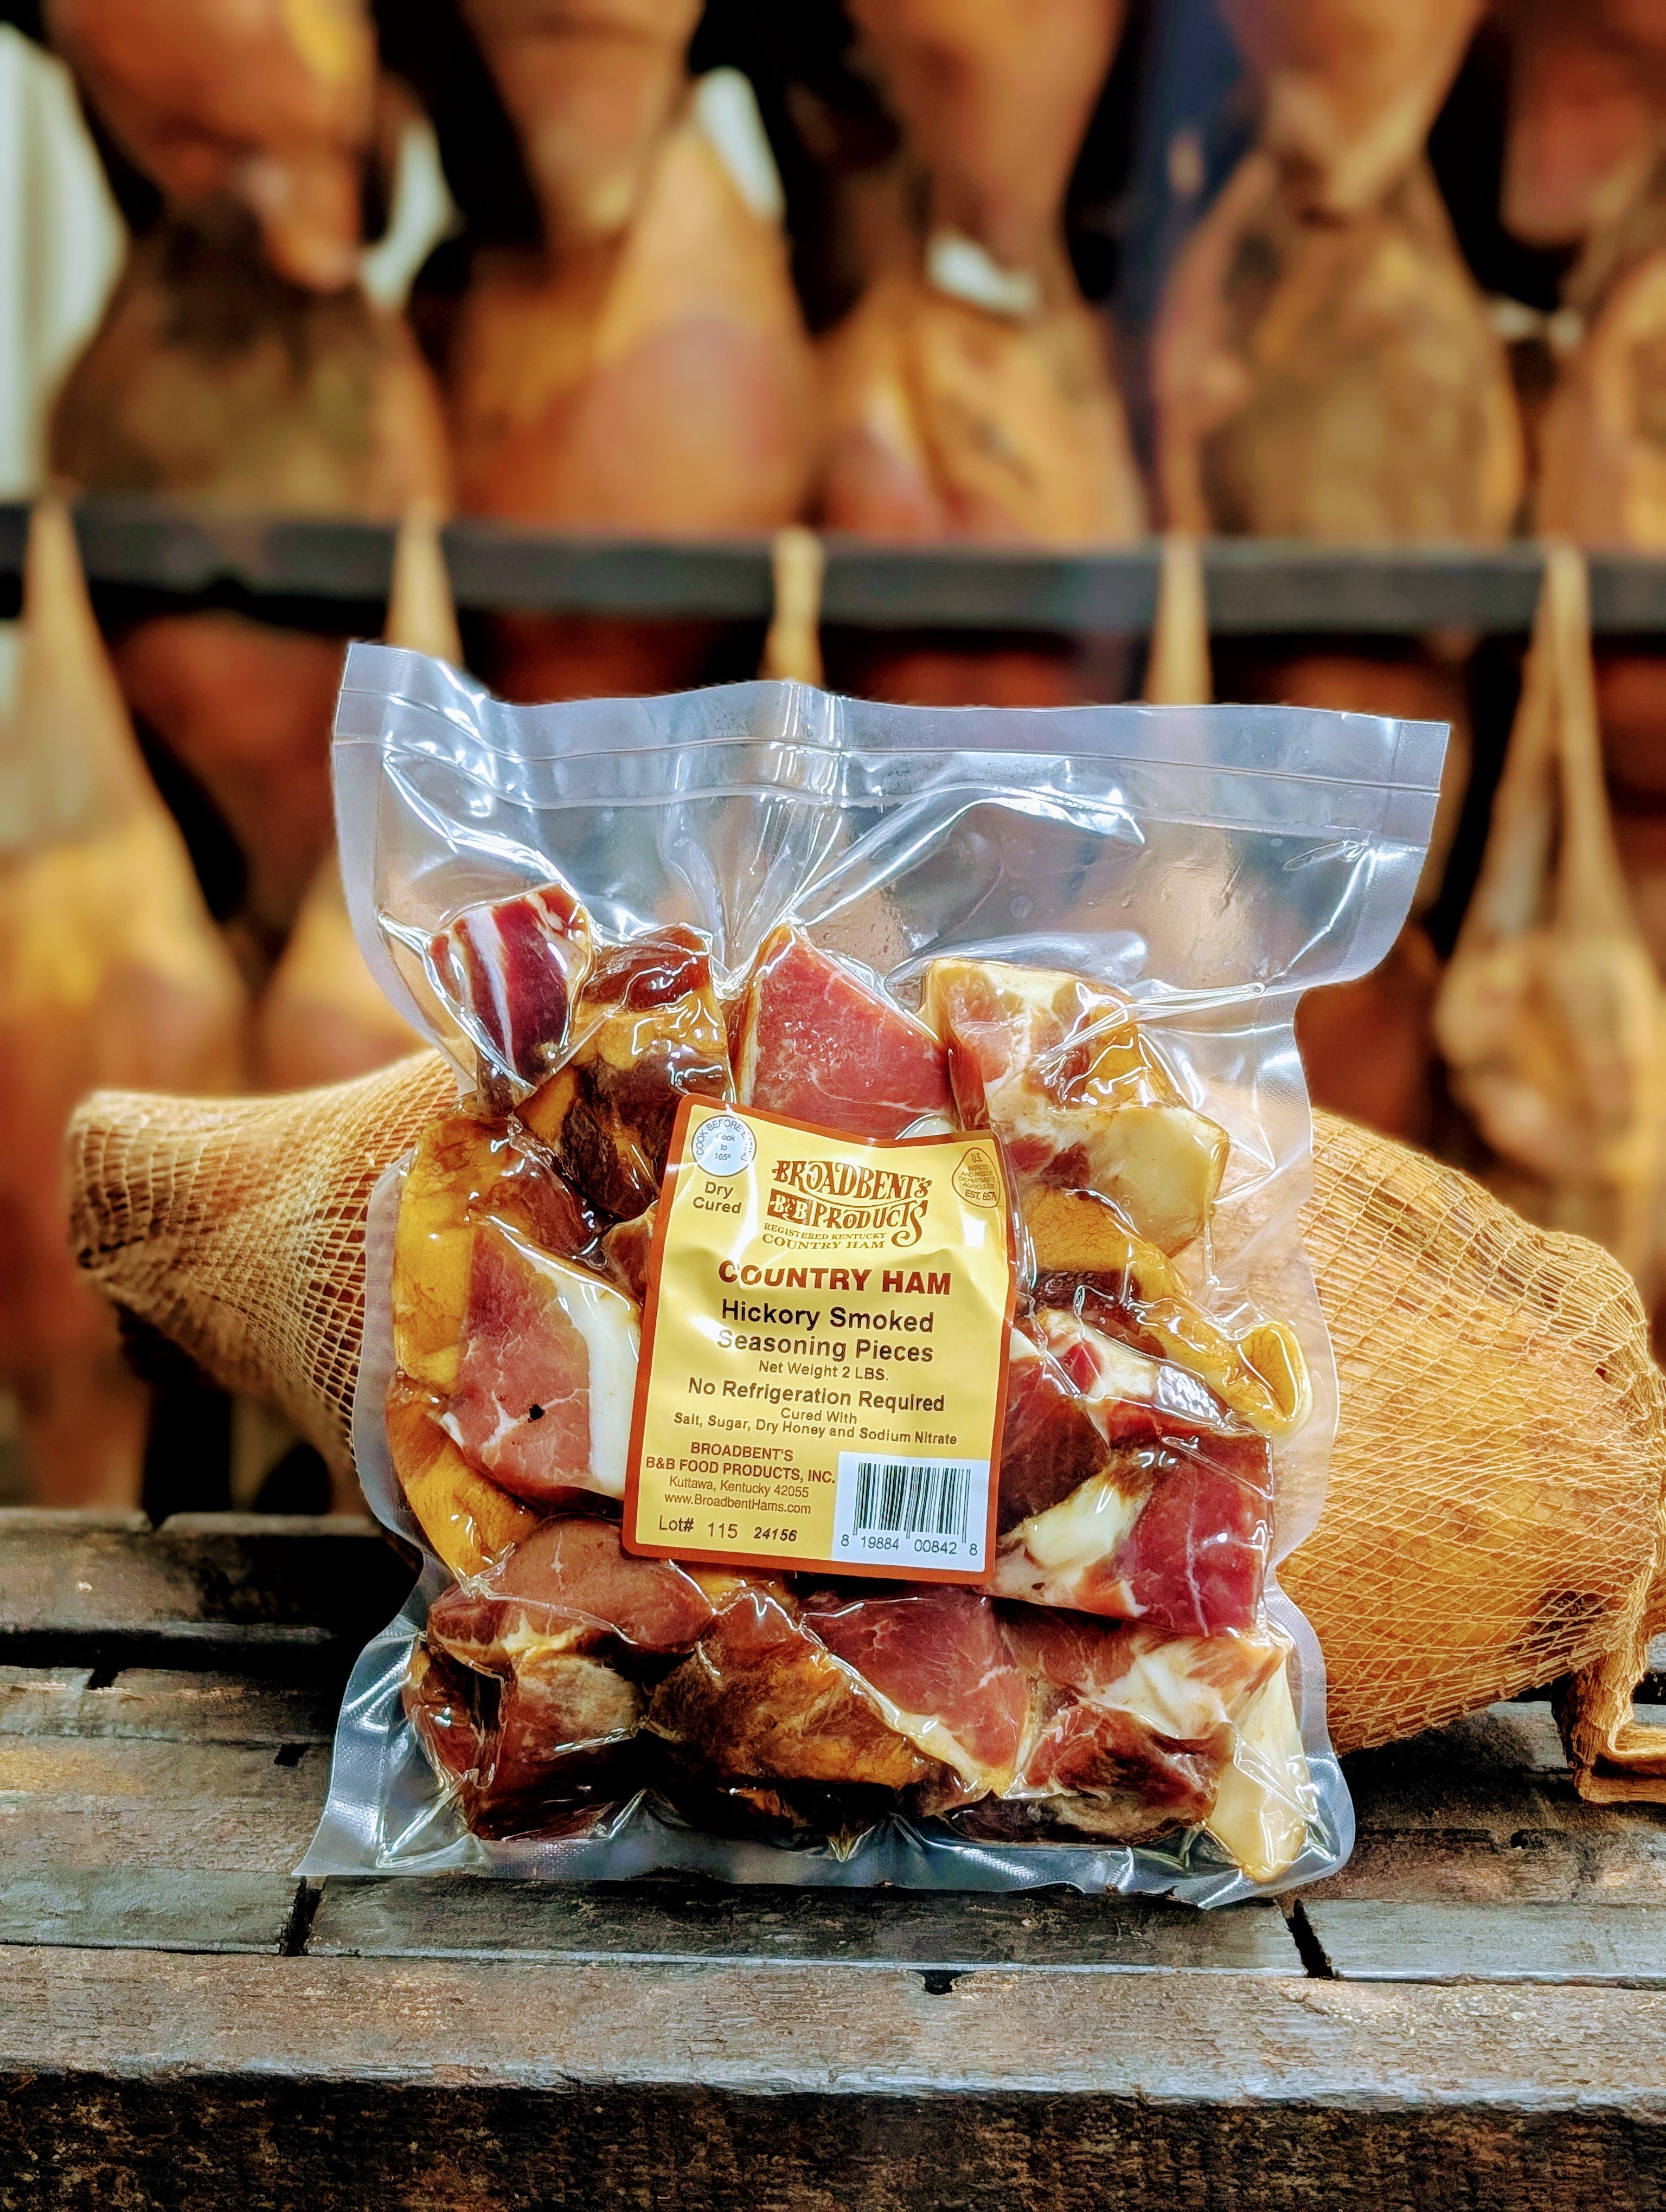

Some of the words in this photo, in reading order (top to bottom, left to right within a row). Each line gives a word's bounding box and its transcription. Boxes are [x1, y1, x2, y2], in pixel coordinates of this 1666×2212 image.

[696, 1129, 708, 1155] COOK
[707, 1119, 742, 1132] BEFORE
[716, 1133, 735, 1142] Cook
[704, 1181, 734, 1199] Dry
[772, 1160, 933, 1203] BROADBENT'S
[693, 1197, 742, 1214] Cured
[764, 1223, 829, 1240] REGISTERED
[811, 1199, 928, 1248] PRODUCTS
[762, 1233, 843, 1250] COUNTRY
[845, 1240, 885, 1249] HAM
[719, 1260, 872, 1291] COUNTRY
[882, 1270, 951, 1295] HAM
[722, 1298, 821, 1331] Hickory
[830, 1307, 934, 1333] Smoked
[717, 1329, 846, 1362] Seasoning
[856, 1339, 934, 1362] Pieces
[759, 1360, 783, 1374] Net
[787, 1361, 837, 1379] Weight
[842, 1366, 850, 1378] 2
[855, 1366, 889, 1381] LBS.
[689, 1377, 715, 1395] No
[722, 1380, 851, 1406] Refrigeration
[858, 1391, 945, 1413] Required
[781, 1407, 822, 1422] Cured
[826, 1411, 857, 1424] With
[674, 1412, 703, 1427] Salt,
[707, 1414, 751, 1431] Sugar,
[756, 1418, 778, 1435] Dry
[783, 1420, 825, 1438] Honey
[829, 1426, 855, 1438] and
[859, 1427, 911, 1443] Sodium
[915, 1431, 957, 1444] Nitrate
[691, 1442, 793, 1462] BROADBENT'S
[646, 1456, 675, 1470] B&B
[680, 1459, 719, 1474] FOOD
[723, 1463, 804, 1483] PRODUCTS,
[808, 1469, 836, 1484] INC.
[669, 1475, 716, 1491] Kuttawa,
[720, 1480, 771, 1498] Kentucky
[773, 1485, 809, 1498] 42055
[664, 1494, 811, 1515] www.BroadbentHams.com
[659, 1515, 694, 1533] Lot#
[708, 1522, 738, 1539] 115
[753, 1526, 798, 1542] 24156
[841, 1534, 849, 1546] 8
[861, 1536, 899, 1550] 19884
[914, 1539, 957, 1554] 00842
[969, 1543, 977, 1556] 8
